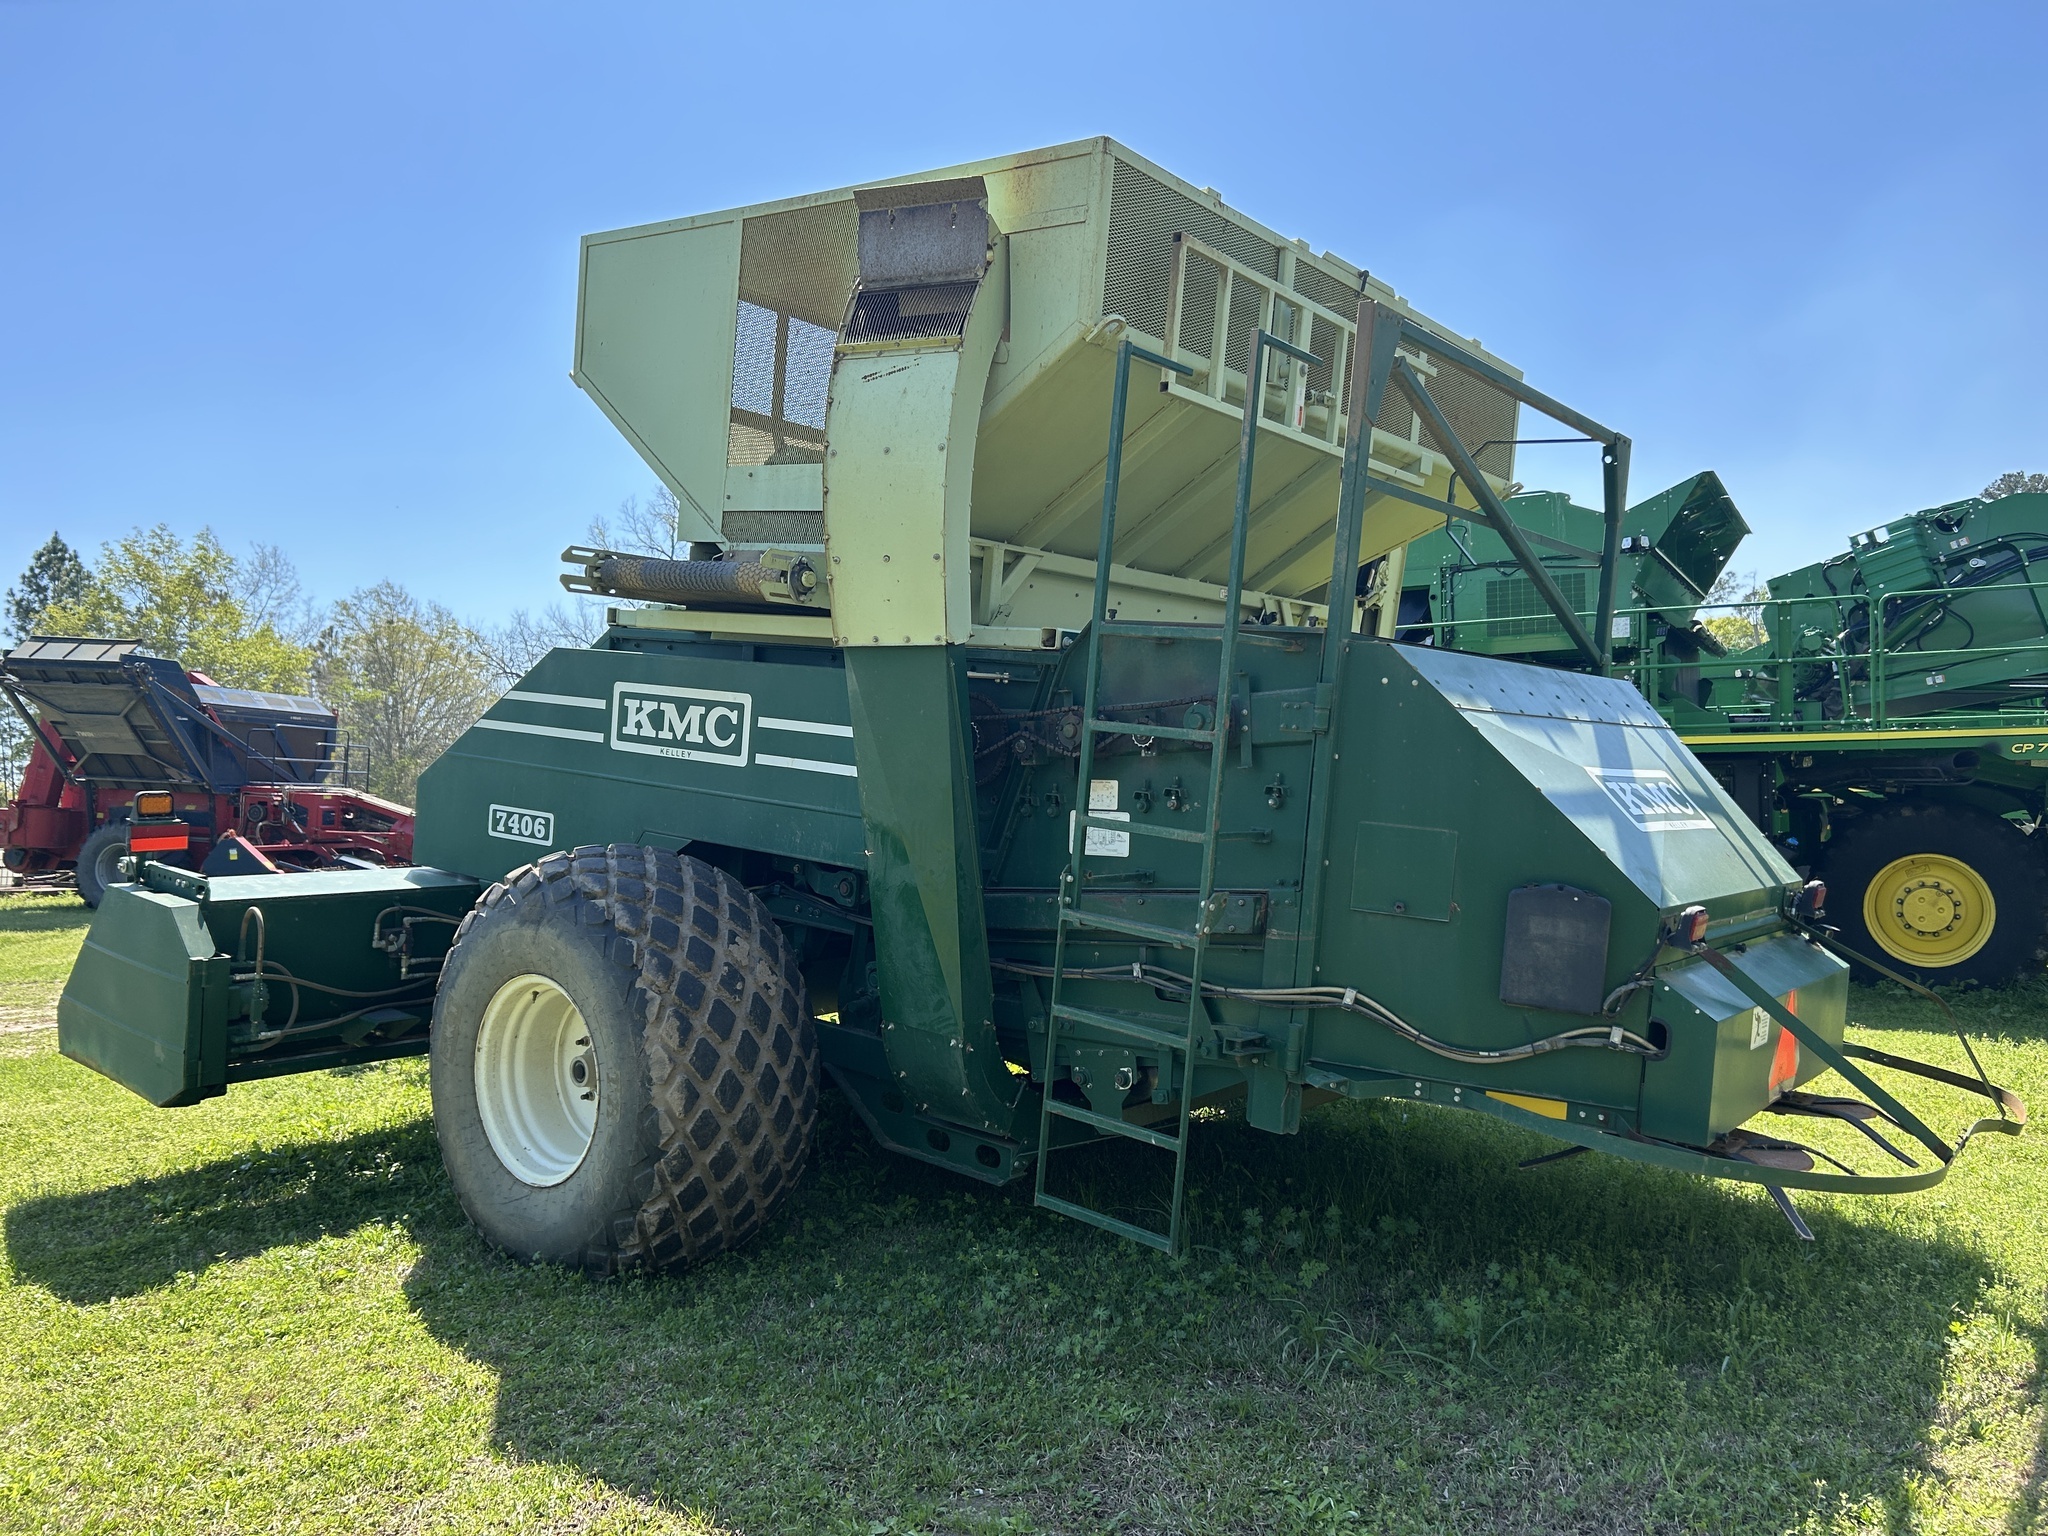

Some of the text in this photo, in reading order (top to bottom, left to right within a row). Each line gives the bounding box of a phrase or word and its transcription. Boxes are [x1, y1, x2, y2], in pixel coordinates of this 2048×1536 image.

[622, 698, 738, 748] KMC
[659, 747, 692, 759] KELLEY
[2011, 743, 2035, 753] CP
[1604, 781, 1695, 816] KMC
[496, 811, 546, 839] 7406
